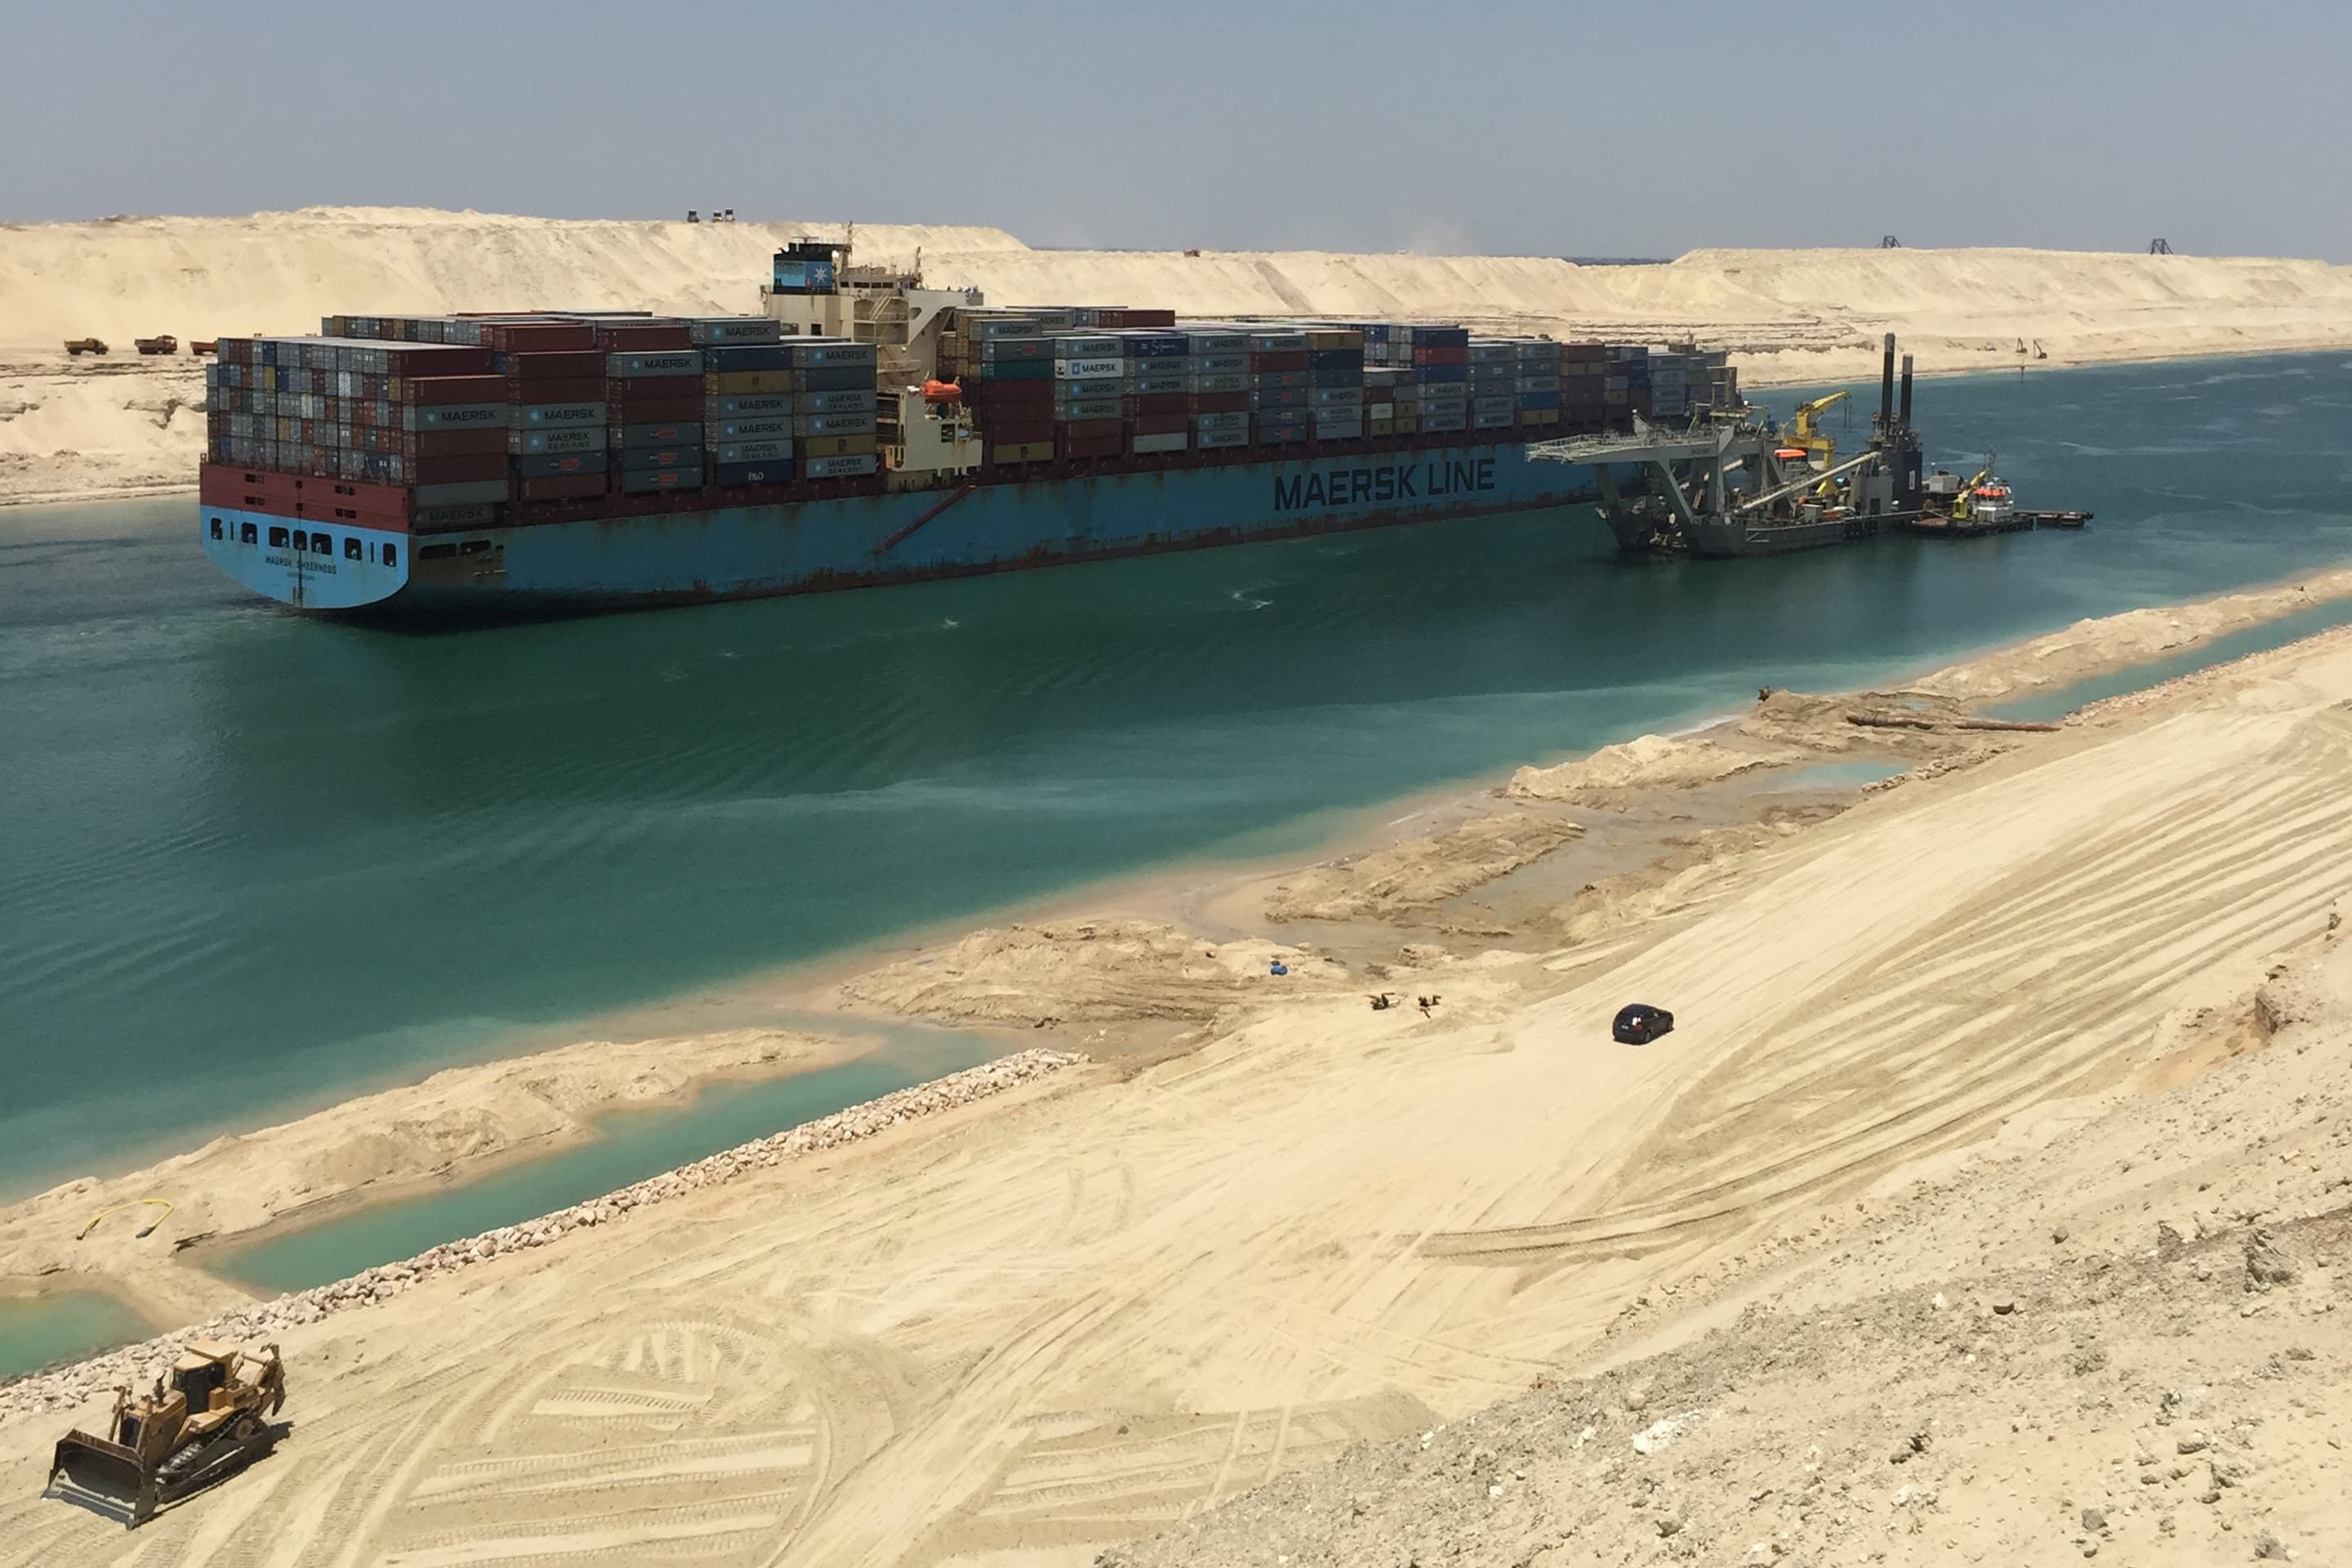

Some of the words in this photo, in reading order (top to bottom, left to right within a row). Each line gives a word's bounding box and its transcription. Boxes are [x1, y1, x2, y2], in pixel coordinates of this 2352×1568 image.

[726, 327, 770, 336] MAERSK
[826, 350, 868, 360] MAERSK
[644, 359, 693, 368] MAERSK
[1082, 363, 1116, 372] MAERSK
[738, 399, 783, 410] MAERSK
[441, 409, 497, 422] MAERSK
[544, 408, 595, 420] MAERSK
[738, 421, 783, 434] MAERSK
[826, 417, 869, 428] MAERSK
[547, 432, 590, 442] MAERSK
[1274, 464, 1417, 511] MAERSK
[1428, 457, 1496, 496] LINE
[429, 508, 484, 521] MAERSK
